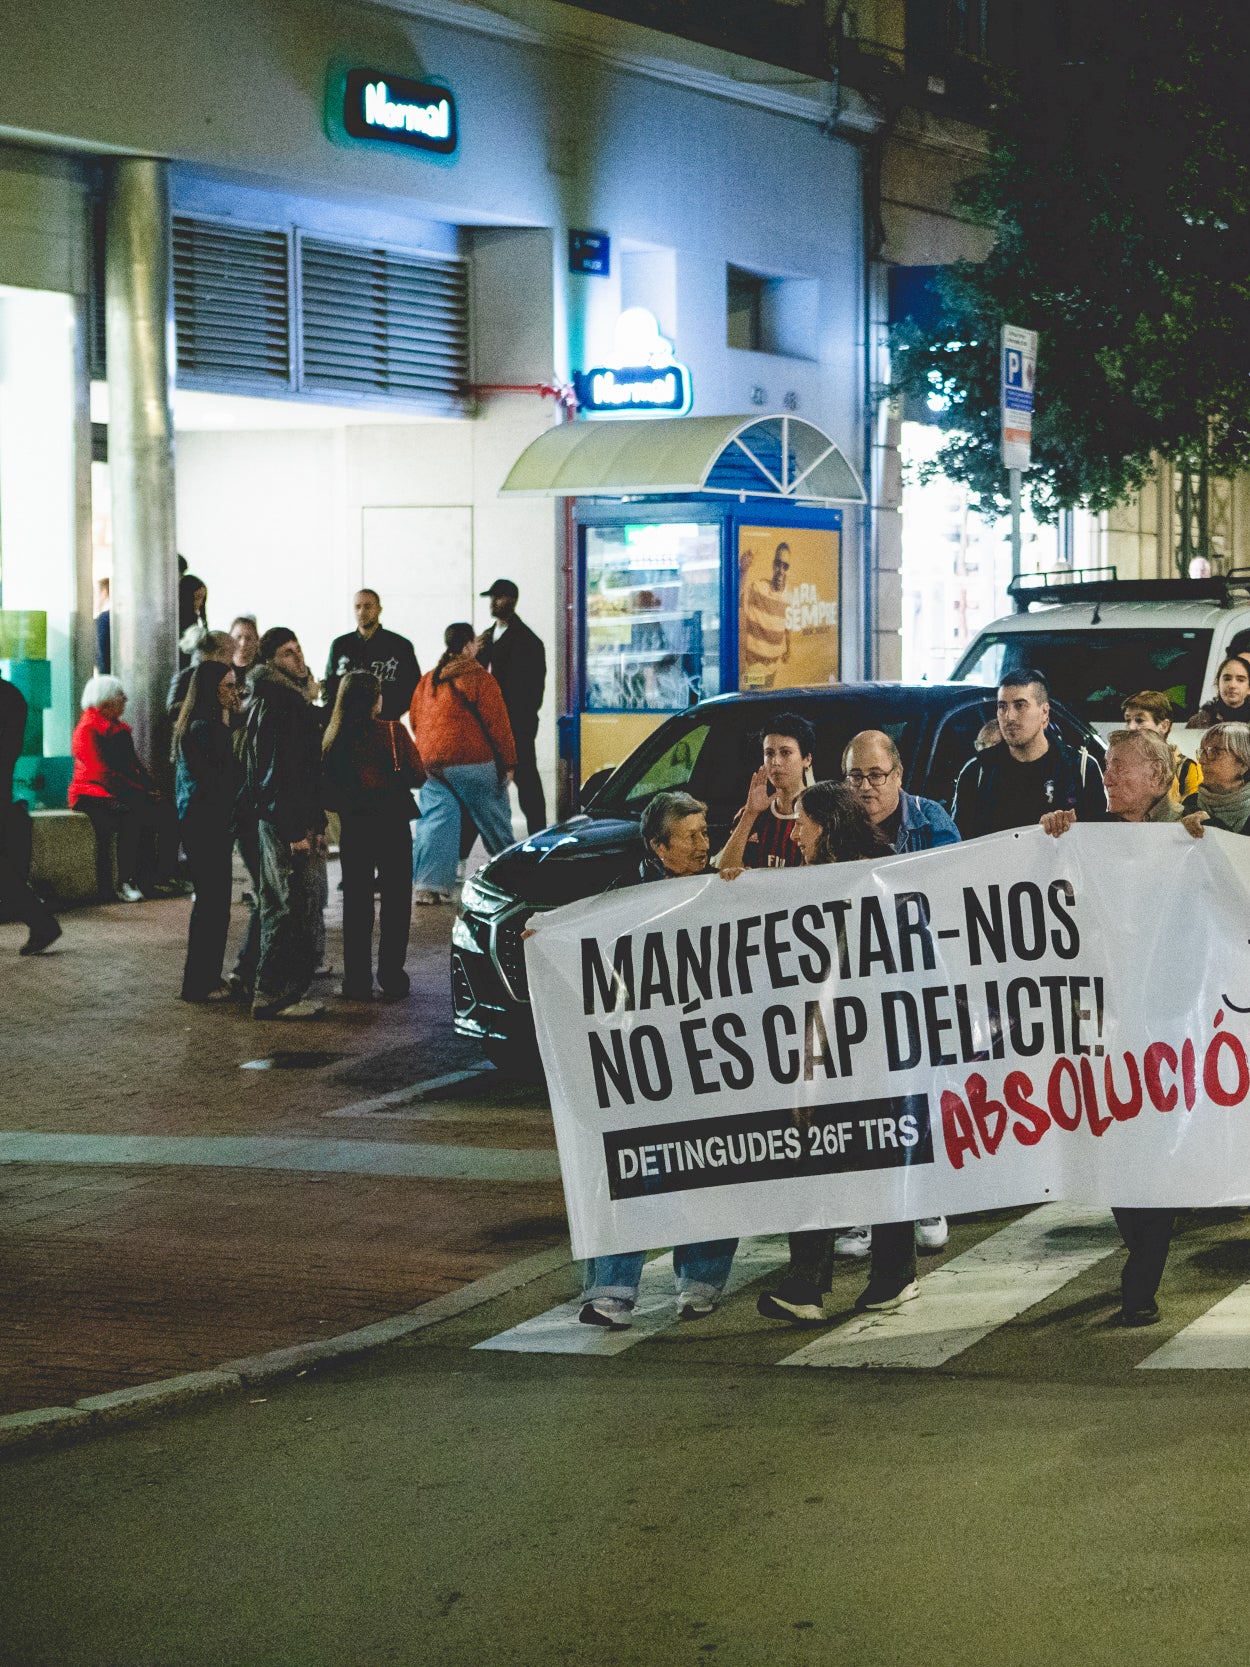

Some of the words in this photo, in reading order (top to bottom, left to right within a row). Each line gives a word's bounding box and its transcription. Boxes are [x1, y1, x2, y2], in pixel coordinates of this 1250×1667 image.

[365, 81, 449, 138] Normal
[593, 371, 676, 404] Normal
[1008, 351, 1020, 384] P
[581, 879, 1080, 1016] MANIFESTAR-NOS
[588, 1024, 673, 1109] NO
[680, 997, 755, 1095] ÉS
[762, 996, 868, 1085] CAP
[881, 976, 1105, 1072] DELICTE!
[617, 1127, 802, 1180] DETINGUDES
[807, 1121, 853, 1157] 26F
[859, 1115, 919, 1151] TRS
